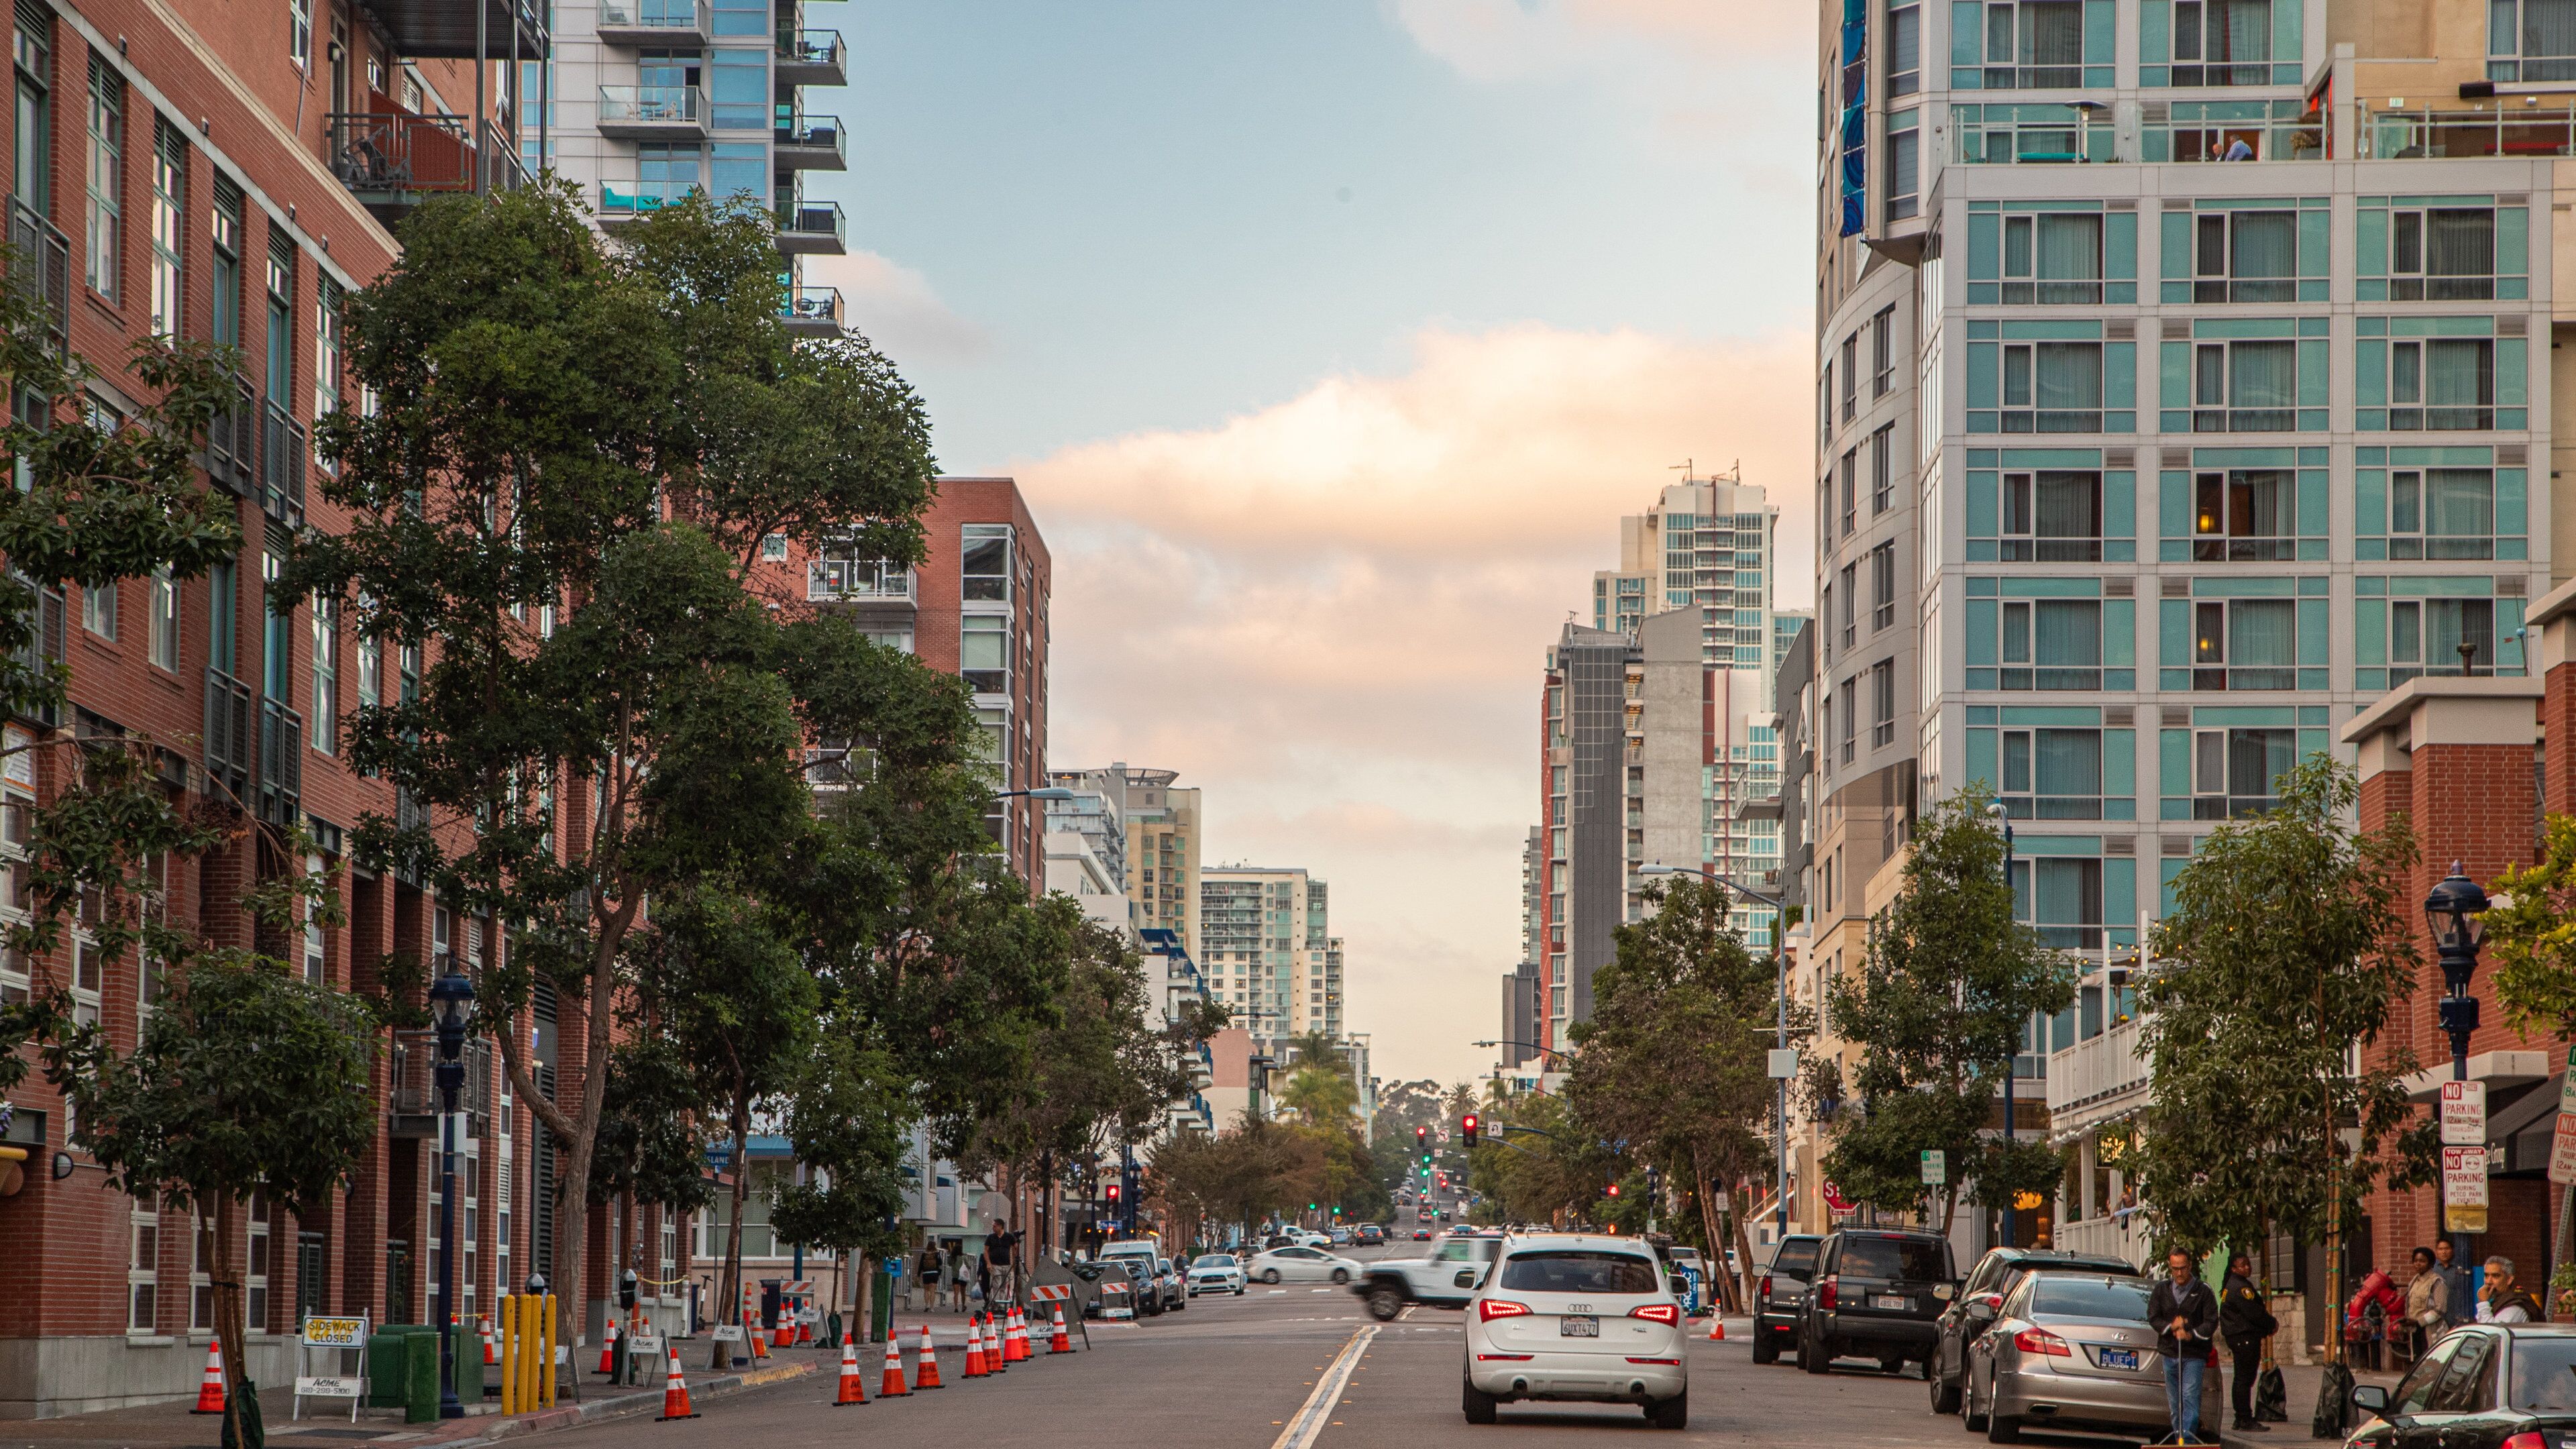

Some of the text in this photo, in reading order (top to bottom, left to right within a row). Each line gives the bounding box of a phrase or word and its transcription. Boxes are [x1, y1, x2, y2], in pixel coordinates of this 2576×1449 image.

[2445, 1083, 2460, 1099] NO
[2446, 1104, 2482, 1115] PARKING
[2447, 1155, 2461, 1169] NO
[2447, 1173, 2483, 1183] PARKING
[309, 1322, 361, 1332] SIDEWALK
[1564, 1324, 1596, 1334] 6UXT477
[314, 1334, 353, 1344] CLOSED
[313, 1379, 341, 1387] ACME
